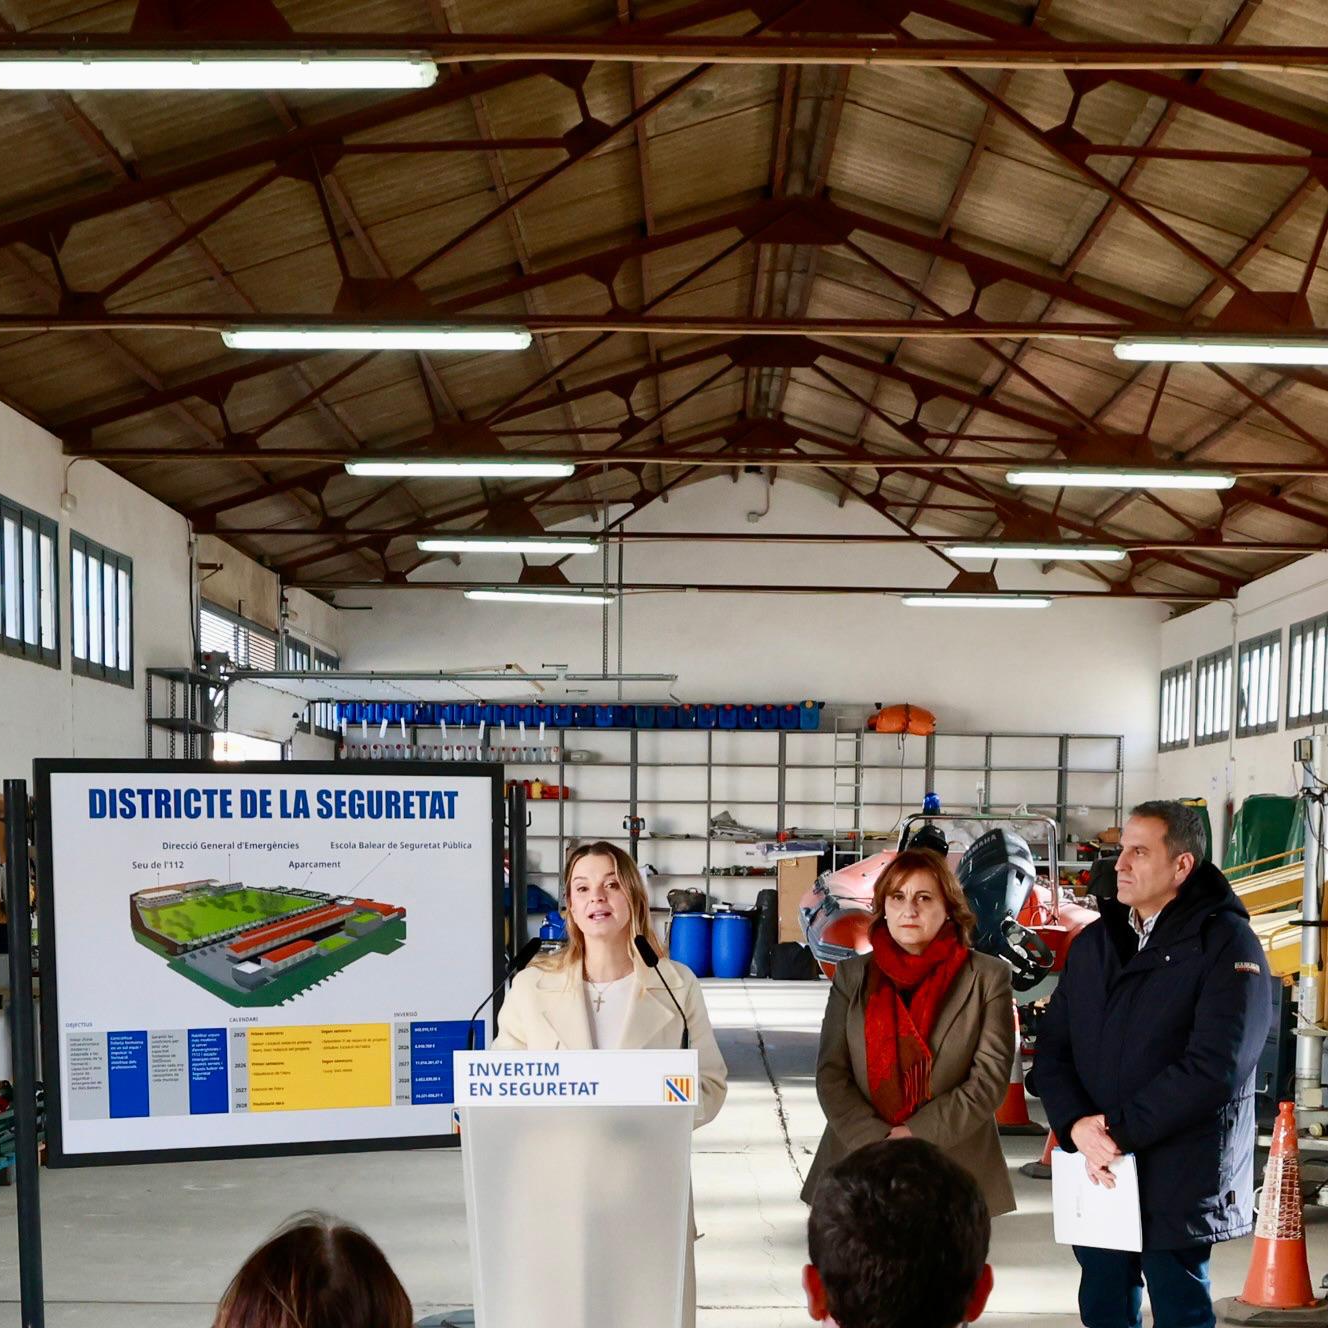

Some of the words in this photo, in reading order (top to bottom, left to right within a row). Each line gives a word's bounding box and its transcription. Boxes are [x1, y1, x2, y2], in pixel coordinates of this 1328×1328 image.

[88, 788, 233, 819] DISTRICTE
[240, 789, 273, 819] DE
[279, 789, 310, 819] LA
[316, 789, 459, 820] SEGURETAT
[162, 841, 198, 850] Direcció
[201, 841, 235, 850] General
[237, 841, 300, 851] d'Emergències
[330, 841, 357, 850] Escola
[359, 841, 385, 850] Balear
[387, 841, 398, 850] de
[400, 841, 441, 851] Seguretat
[443, 841, 472, 850] Pública
[132, 861, 149, 869] Seu
[150, 861, 162, 869] de
[288, 861, 341, 870] Aparcament
[468, 1062, 560, 1077] INVERTIM
[469, 1082, 493, 1096] EN
[498, 1082, 599, 1097] SEGURETAT
